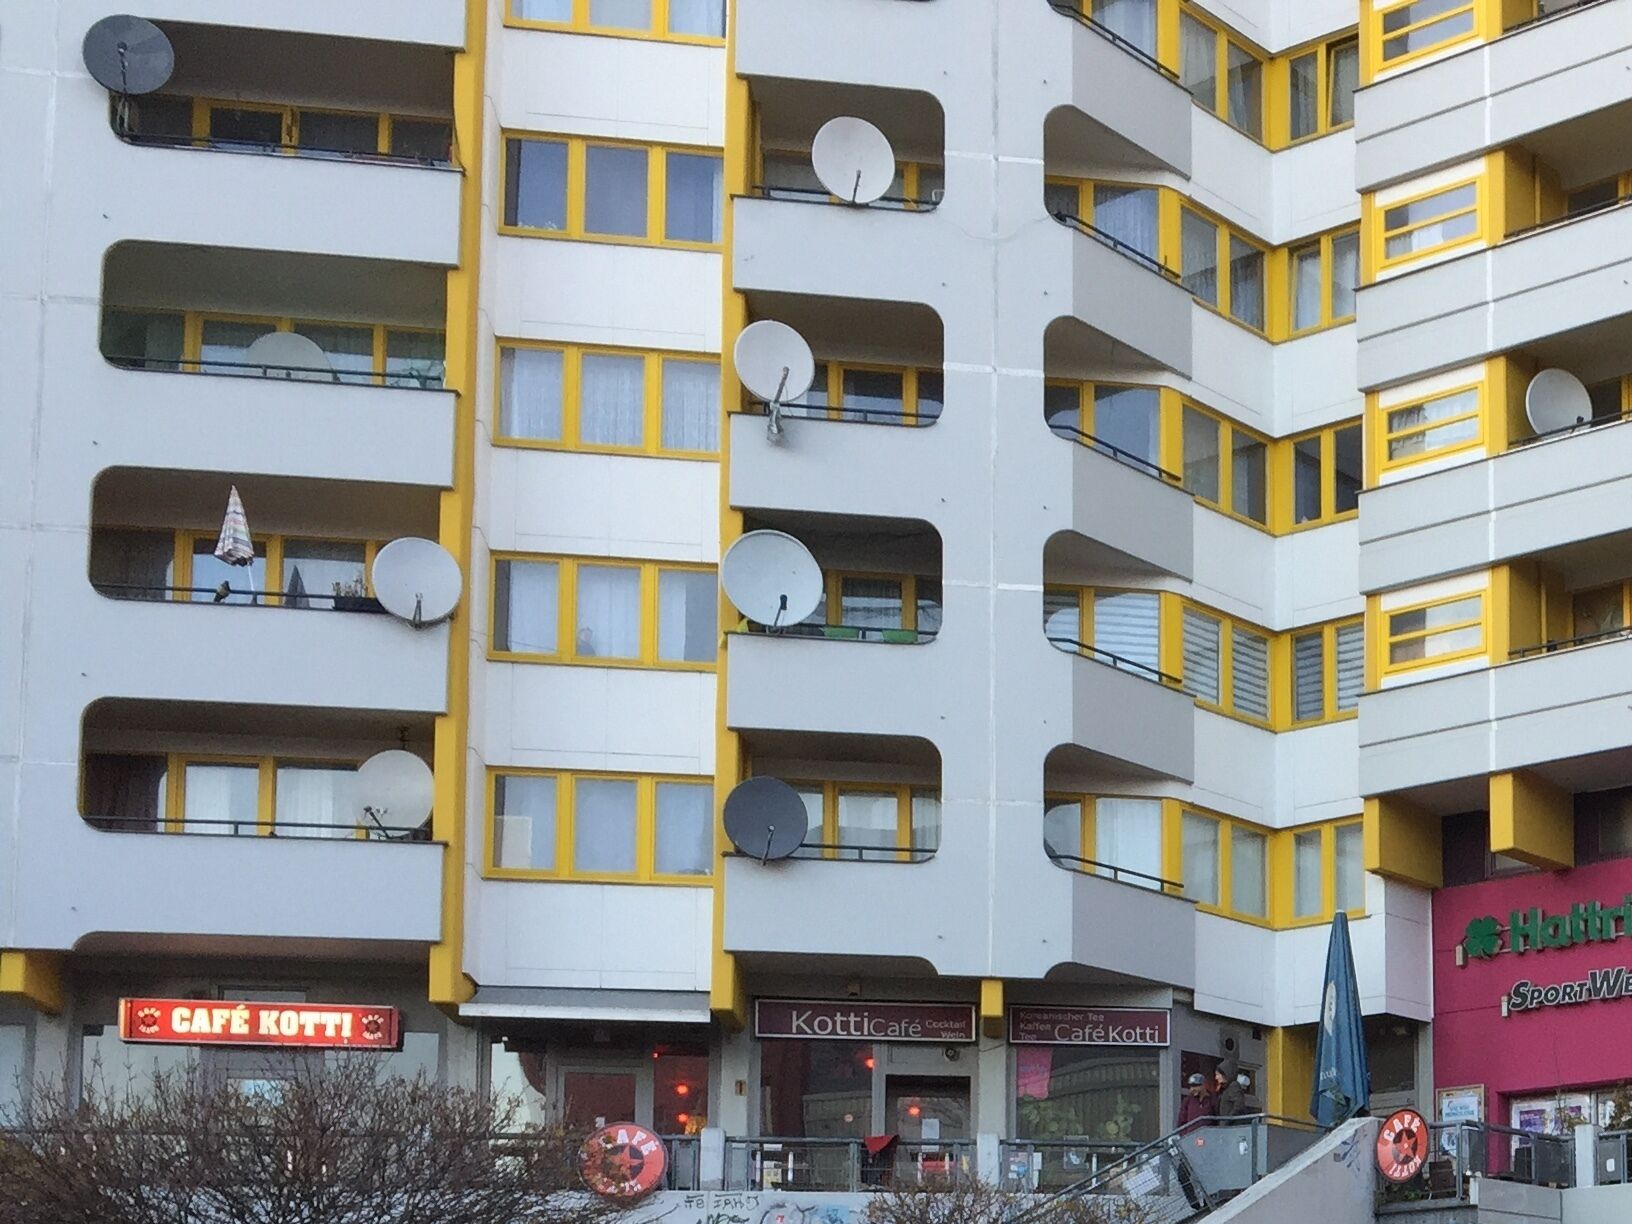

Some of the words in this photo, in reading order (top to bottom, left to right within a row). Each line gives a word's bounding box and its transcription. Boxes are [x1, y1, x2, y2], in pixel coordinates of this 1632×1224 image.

[171, 1004, 250, 1034] CAFÉ
[1087, 1012, 1105, 1022] Tee
[1054, 1019, 1105, 1043] Café
[1108, 1025, 1159, 1044] Kotti
[1384, 1114, 1421, 1142] CAFÉ
[1389, 1155, 1422, 1177] KOTTI
